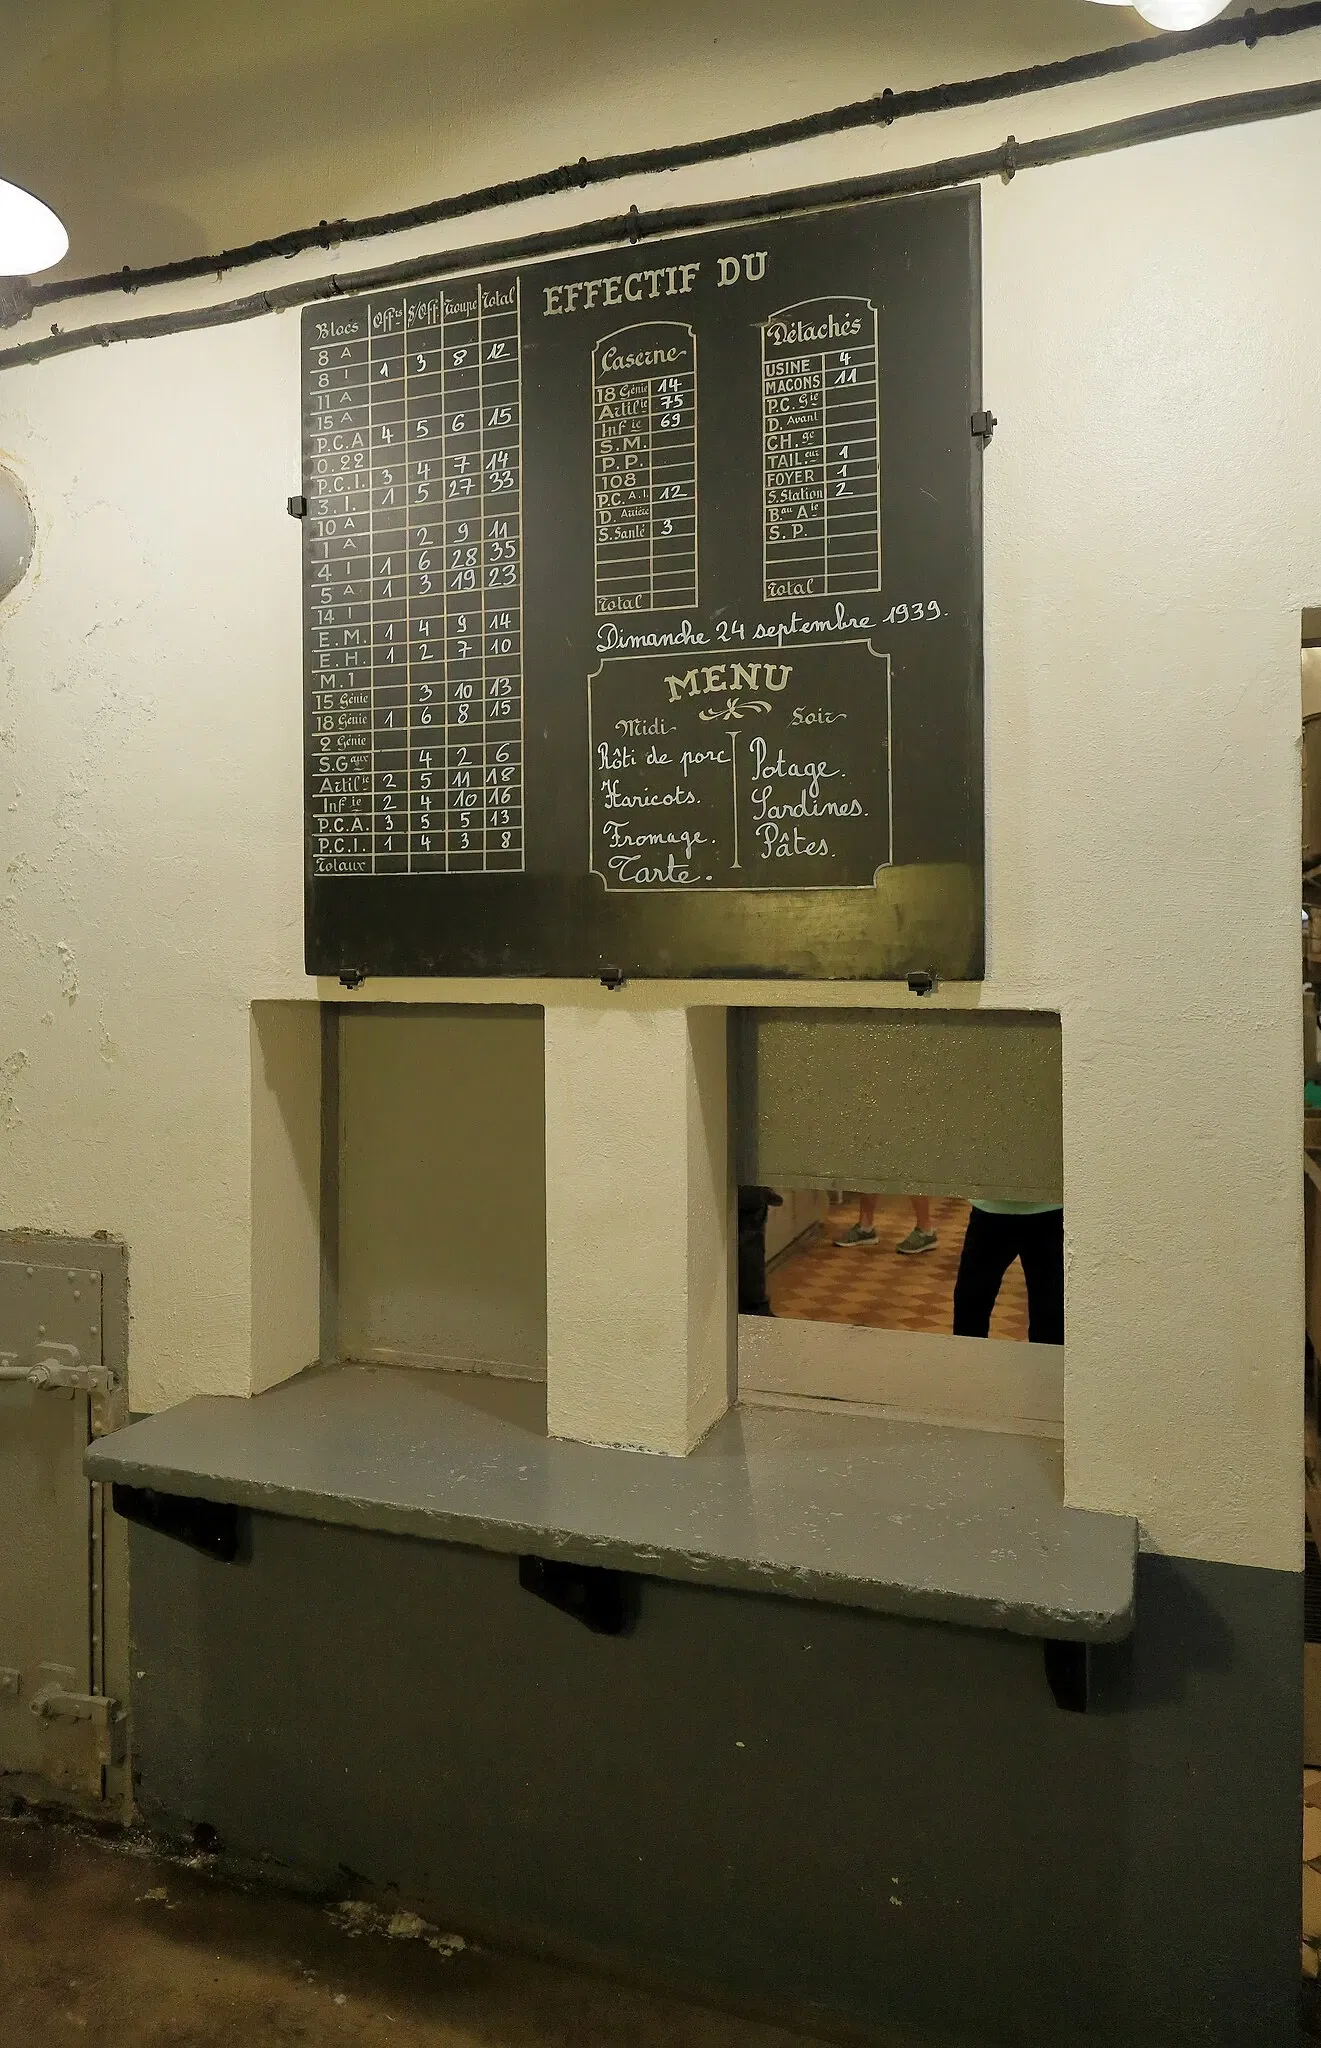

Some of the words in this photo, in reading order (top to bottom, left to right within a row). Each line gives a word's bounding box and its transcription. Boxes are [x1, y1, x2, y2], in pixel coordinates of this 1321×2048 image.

[543, 262, 700, 317] EFFECTIF
[718, 251, 769, 288] DU
[482, 286, 515, 310] Total
[315, 321, 359, 340] Blocs
[767, 313, 862, 346] Détachés
[318, 351, 329, 366] 8
[340, 347, 352, 358] A
[379, 362, 389, 377] 1
[417, 354, 426, 372] 3
[453, 350, 467, 366] 8
[486, 343, 510, 360] 12
[598, 346, 687, 380] Caserne
[839, 352, 851, 366] 4
[766, 359, 810, 377] USINE
[834, 368, 857, 384] 11
[318, 373, 329, 388] 8
[657, 378, 682, 392] 14
[317, 395, 330, 410] 11
[340, 392, 352, 403] A
[597, 387, 616, 403] 18
[660, 394, 684, 410] 75
[317, 416, 333, 430] 15
[340, 412, 353, 423] A
[381, 425, 394, 443] 4
[416, 420, 429, 438] 5
[452, 414, 465, 432] 6
[488, 408, 512, 426] 15
[660, 413, 681, 427] 69
[767, 418, 783, 432] D.
[786, 411, 818, 425] Avant
[839, 446, 849, 459] 1
[383, 469, 392, 485] 3
[417, 463, 430, 479] 4
[454, 456, 470, 474] 7
[485, 450, 508, 469] 14
[837, 465, 847, 477] 1
[381, 488, 394, 505] 1
[415, 483, 430, 503] 5
[449, 478, 476, 498] 27
[491, 471, 514, 492] 33
[602, 473, 637, 490] 108
[767, 469, 815, 487] FOYER
[659, 485, 688, 500] 12
[836, 483, 853, 497] 2
[317, 519, 336, 537] 10
[344, 517, 355, 528] A
[417, 527, 433, 546] 2
[453, 523, 469, 543] 9
[488, 520, 508, 539] 11
[661, 519, 673, 535] 3
[344, 539, 356, 549] A
[380, 557, 391, 575] 1
[419, 551, 431, 571] 6
[451, 548, 478, 569] 28
[490, 540, 516, 562] 35
[317, 564, 332, 581] 4
[383, 580, 392, 598] 1
[419, 574, 432, 595] 3
[451, 569, 476, 590] 19
[488, 564, 517, 586] 23
[320, 588, 333, 604] 5
[343, 585, 355, 595] A
[768, 578, 814, 596] Total
[599, 594, 643, 611] Total
[317, 610, 335, 624] 14
[385, 624, 393, 640] 1
[419, 620, 429, 637] 4
[456, 615, 467, 633] 9
[489, 613, 512, 629] 14
[595, 620, 711, 653] Dimanche
[716, 620, 745, 641] 24
[753, 601, 878, 648] septembre
[883, 600, 949, 625] 1939.
[386, 647, 394, 664] 1
[419, 644, 434, 660] 2
[458, 641, 472, 658] 7
[490, 639, 512, 655] 10
[419, 685, 433, 701] 3
[454, 683, 473, 699] 10
[489, 678, 513, 697] 13
[664, 663, 793, 703] MENU
[315, 694, 334, 710] 15
[316, 716, 334, 731] 18
[385, 711, 393, 728] 1
[420, 706, 432, 724] 6
[458, 704, 469, 724] 8
[490, 700, 511, 717] 15
[788, 706, 848, 728] Soir
[614, 717, 677, 738] Midi
[320, 737, 331, 752] 2
[419, 750, 432, 769] 4
[456, 748, 472, 767] 2
[495, 743, 510, 762] 6
[598, 742, 636, 770] Rôti
[646, 746, 673, 766] de
[680, 748, 732, 777] porc
[750, 736, 846, 798] Potage.
[383, 774, 397, 788] 2
[420, 772, 432, 789] 5
[452, 771, 470, 787] 11
[486, 767, 516, 785] 18
[383, 795, 397, 811] 2
[420, 795, 431, 810] 4
[453, 790, 478, 807] 10
[488, 787, 513, 805] 16
[600, 778, 702, 809] Haricots.
[750, 786, 870, 821] Sardines.
[385, 814, 394, 830] 3
[420, 814, 430, 829] 5
[460, 812, 470, 828] 5
[490, 810, 510, 826] 13
[384, 836, 392, 851] 1
[420, 835, 431, 851] 4
[460, 833, 469, 849] 3
[501, 832, 511, 849] 8
[603, 820, 716, 860] Fromage.
[755, 822, 836, 859] Pâtes.
[315, 858, 366, 872] Totaux
[608, 853, 713, 884] Tarte.
